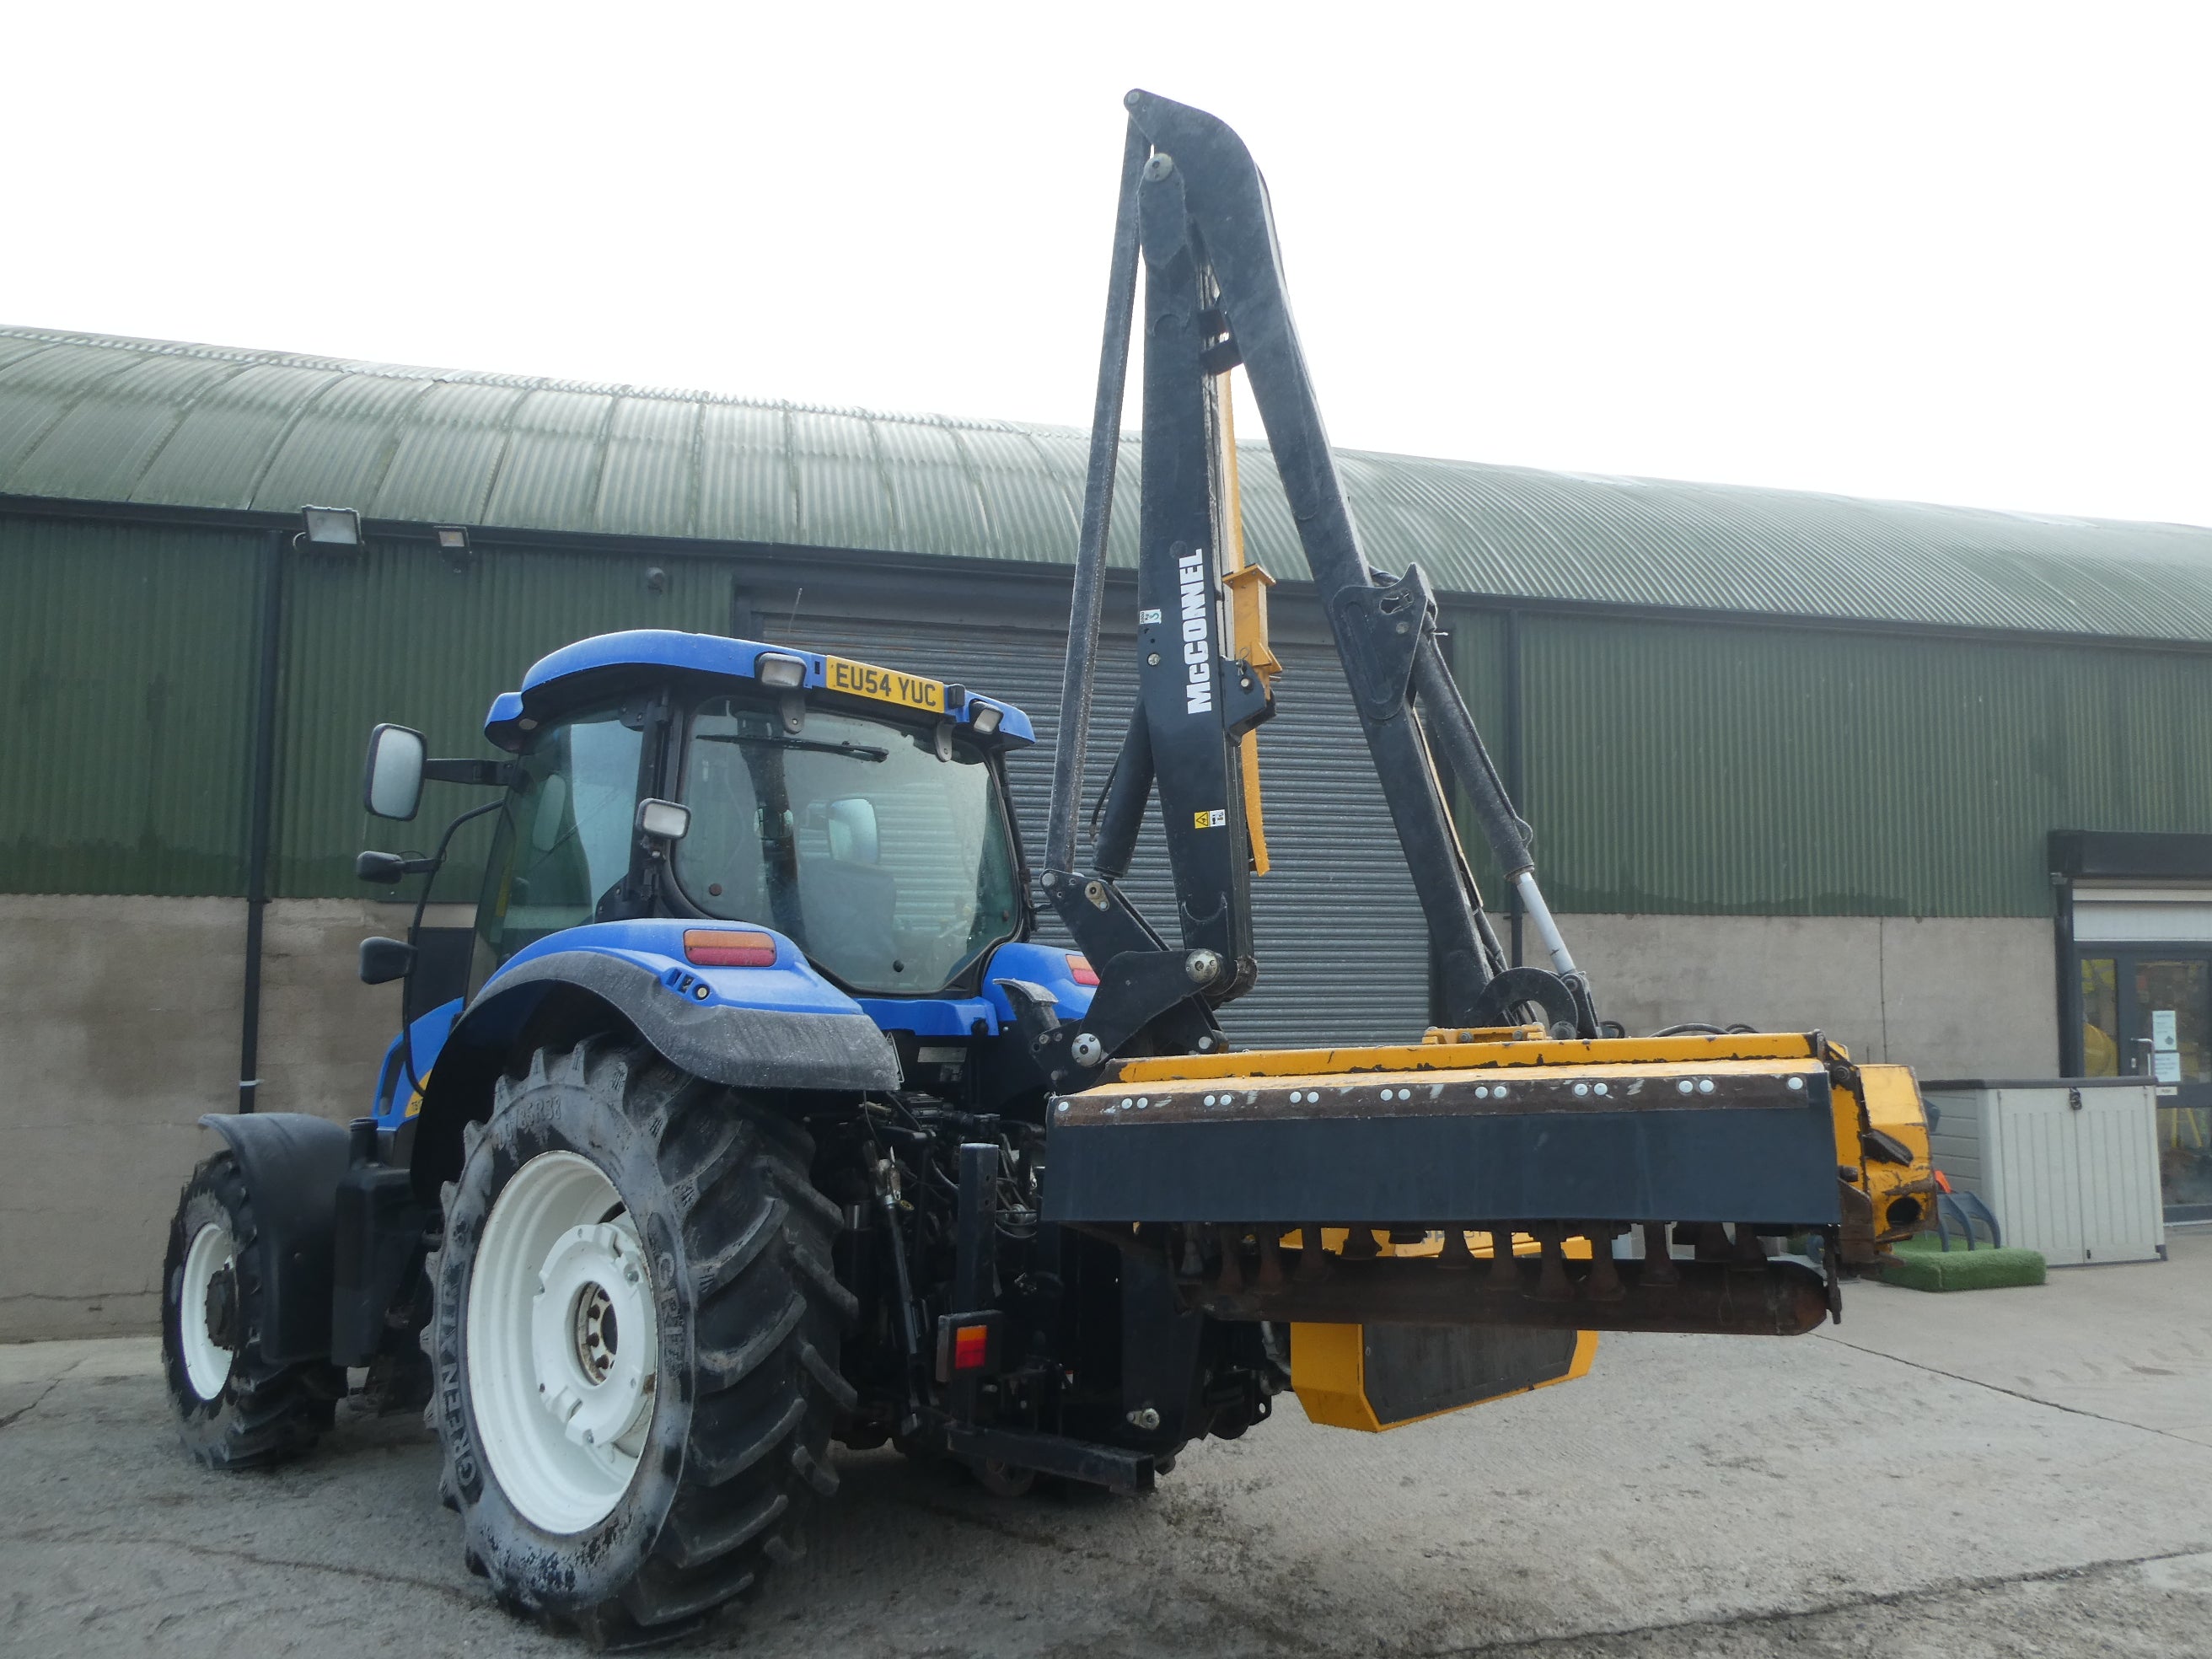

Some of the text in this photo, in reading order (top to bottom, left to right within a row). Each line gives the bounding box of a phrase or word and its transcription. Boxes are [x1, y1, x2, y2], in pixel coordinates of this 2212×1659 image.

[835, 662, 937, 707] EU54 YUC
[658, 1251, 685, 1335] GRI
[441, 1361, 478, 1487] GREEN
